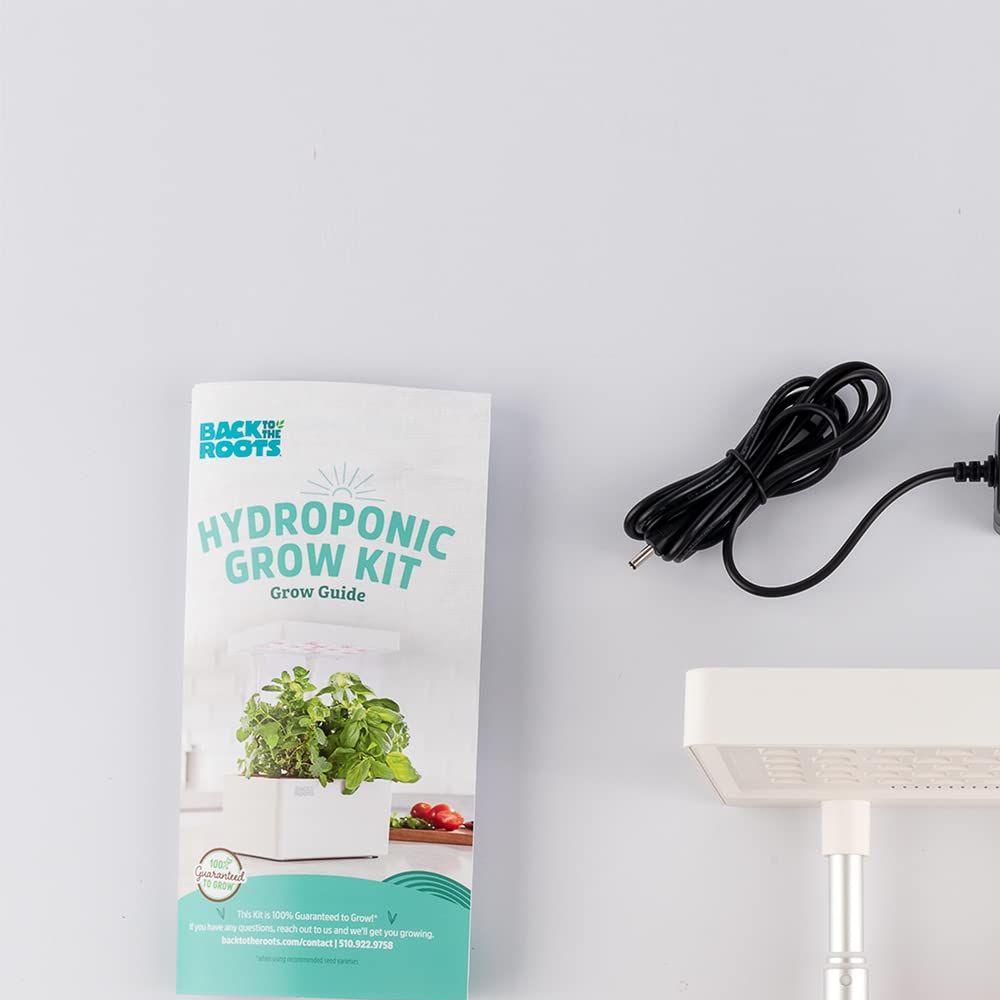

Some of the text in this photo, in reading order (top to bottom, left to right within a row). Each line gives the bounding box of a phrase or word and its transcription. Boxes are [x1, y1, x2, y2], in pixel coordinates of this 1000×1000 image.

[200, 420, 276, 441] BACK TO
[262, 430, 281, 438] THE
[200, 440, 281, 459] ROOTS
[198, 501, 456, 560] HYDROPONIC
[225, 543, 422, 590] GROW KIT
[270, 586, 366, 602] Grow Guide
[195, 865, 246, 882] Guaranteed
[204, 880, 236, 890] TO GROW
[237, 910, 252, 919] This
[253, 910, 263, 919] Kit
[264, 911, 270, 919] is
[272, 911, 293, 920] 100%
[294, 912, 340, 921] Guaranteed
[341, 914, 349, 922] to
[194, 924, 206, 933] you
[224, 924, 236, 933] any
[238, 925, 275, 933] questions,
[277, 925, 298, 933] reach
[334, 926, 349, 934] and
[369, 929, 382, 937] get
[400, 930, 434, 939] growing.
[221, 936, 394, 950] backtotheroots.com/contact 510.922.9758
